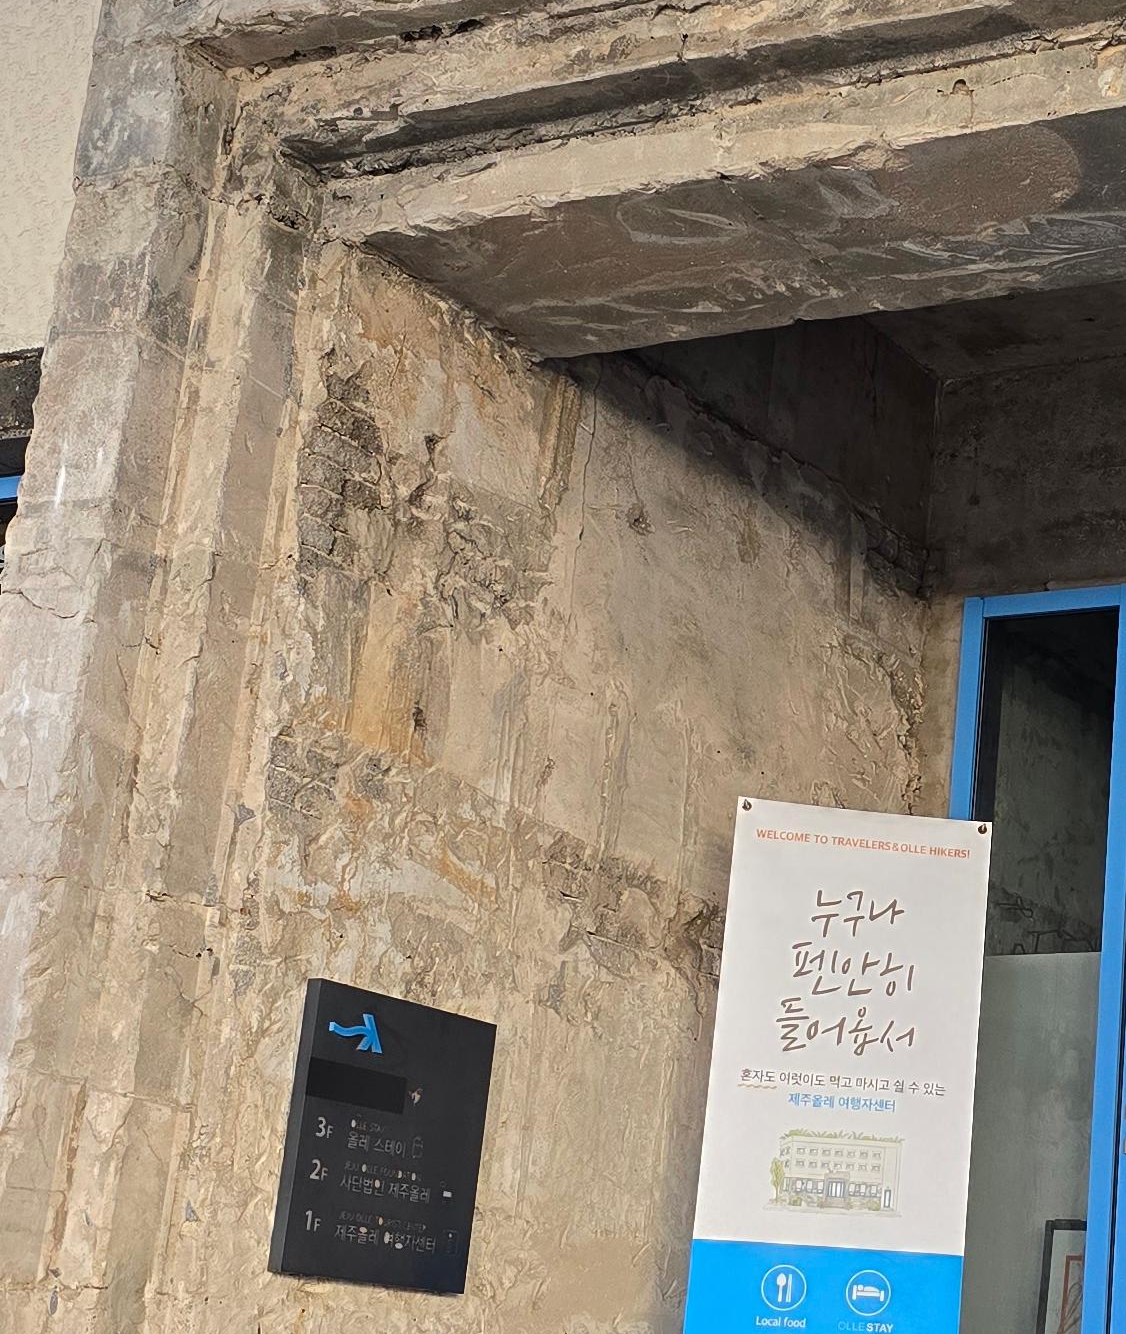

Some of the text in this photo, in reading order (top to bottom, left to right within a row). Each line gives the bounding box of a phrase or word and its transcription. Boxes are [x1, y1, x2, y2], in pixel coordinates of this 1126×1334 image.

[756, 828, 811, 843] WELCOME
[814, 834, 829, 845] TO
[929, 846, 971, 859] HIKERS!
[811, 889, 905, 938] 누구나
[775, 997, 915, 1056] 들어옵서
[741, 1068, 776, 1083] 혼자도
[829, 1075, 852, 1088] 먹고
[855, 1077, 890, 1091] 마시고
[908, 1081, 919, 1094] 수
[923, 1083, 946, 1097] 있는
[788, 1093, 896, 1113] 제주올레 여행자센터
[315, 1116, 334, 1139] 3F
[347, 1131, 406, 1159] 올레 스테이
[309, 1159, 329, 1181] 2F
[340, 1174, 431, 1204] 사단법인 제주올레
[305, 1210, 322, 1232] 1F
[334, 1224, 436, 1254] 제주올레 여행자센터
[756, 1316, 806, 1328] Local food
